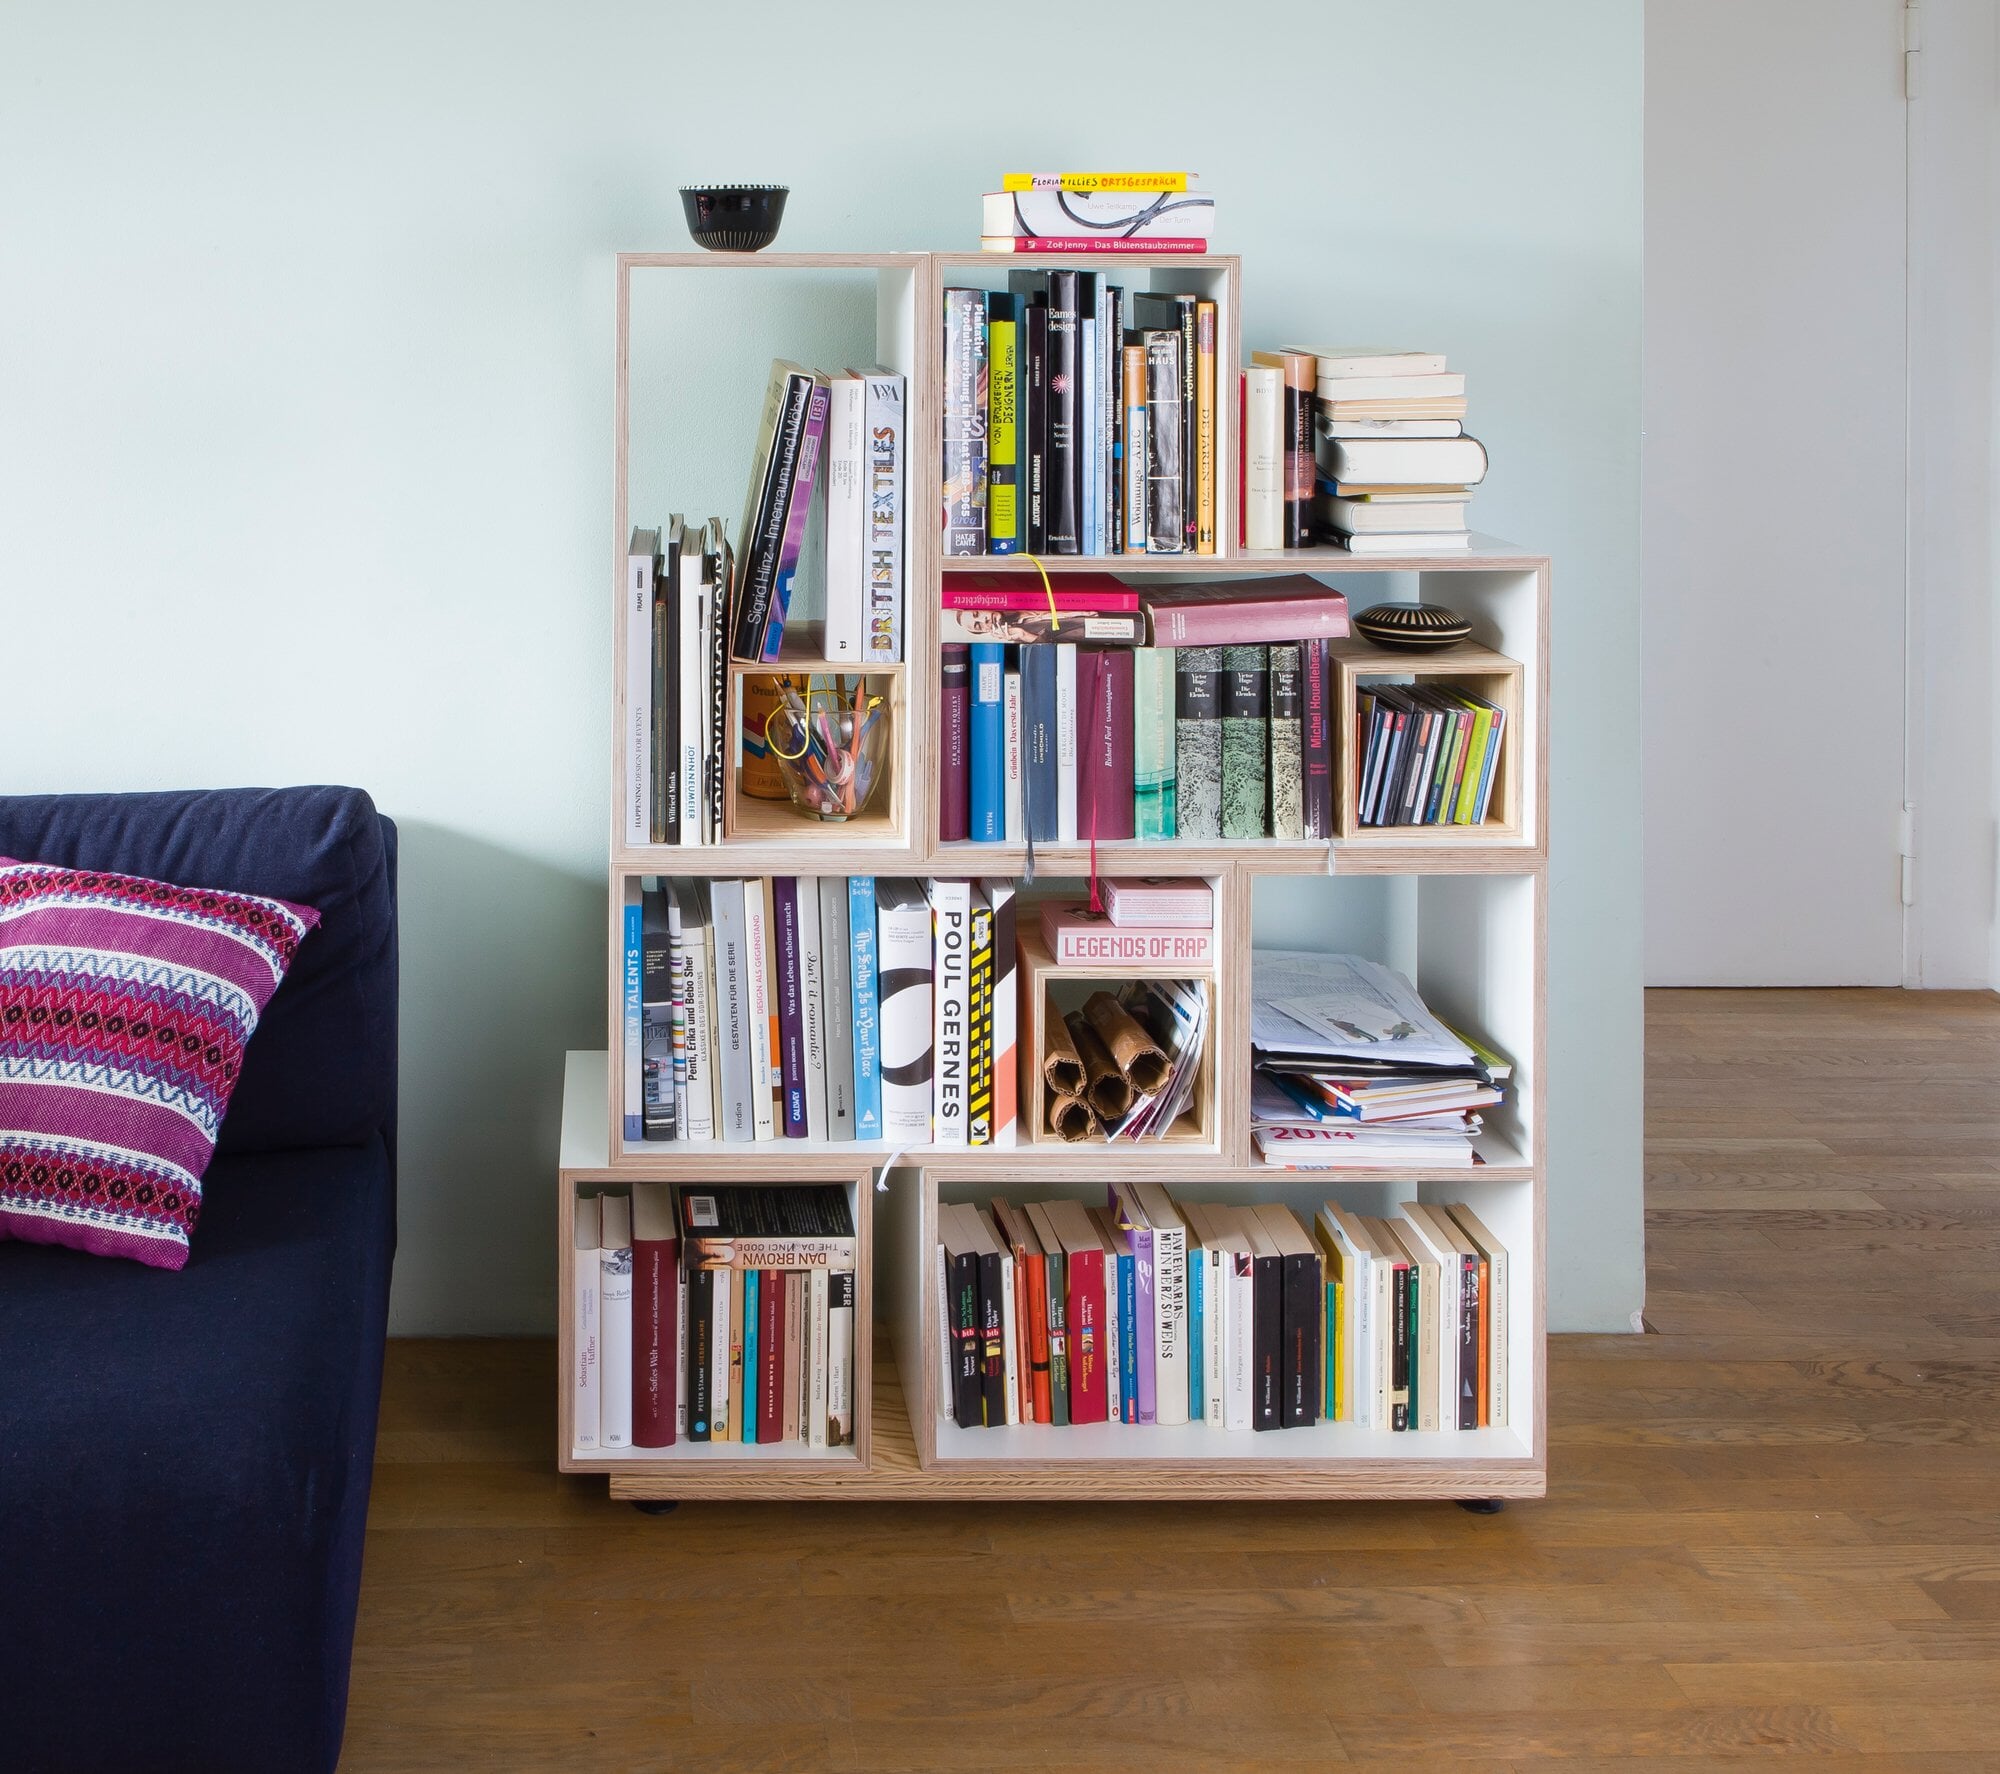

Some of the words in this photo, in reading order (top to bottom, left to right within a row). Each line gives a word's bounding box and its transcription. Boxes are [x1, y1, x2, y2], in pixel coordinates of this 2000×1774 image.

[1031, 177, 1066, 186] FLORIAN
[1067, 177, 1098, 187] ILLIES
[1100, 177, 1177, 187] ORTSGESPRÄCH
[1087, 202, 1104, 211] Uwe
[1172, 216, 1191, 224] Turm
[1046, 240, 1064, 249] Zoë
[1064, 240, 1088, 251] Jenny
[1094, 240, 1111, 249] Das
[1113, 240, 1195, 250] Blütenstaubzimmer
[1049, 308, 1077, 320] Eames
[974, 303, 985, 357] Plakativ!
[1048, 320, 1077, 334] design
[961, 304, 973, 402] Produktwerbung
[1148, 357, 1175, 365] HAUS
[1184, 313, 1196, 403] wohnraumfibel
[871, 384, 899, 402] V&A
[993, 369, 1003, 425] ERFOLGREICHEN
[1003, 370, 1015, 425] DESIGNERN
[786, 390, 806, 435] Möbel
[811, 398, 825, 418] SED
[963, 403, 973, 418] im
[1201, 408, 1210, 430] DE
[962, 420, 972, 458] Plakat
[994, 427, 1003, 446] VON
[780, 437, 797, 465] und
[1201, 431, 1210, 482] JAREN
[871, 426, 895, 543] TEXTILES
[1033, 454, 1041, 493] HANDMADE
[764, 467, 791, 539] Innenraum
[1131, 468, 1145, 528] Wohnungs
[755, 552, 775, 582] Hinz
[747, 585, 769, 625] Sigrid
[871, 550, 895, 651] BRITISH
[1009, 694, 1017, 709] Jahr
[635, 707, 643, 737] EVENTS
[1104, 725, 1112, 741] Ford
[1309, 711, 1322, 749] Michel
[635, 737, 643, 753] FOR
[1009, 729, 1017, 743] Das
[688, 745, 696, 771] JOHN
[1009, 747, 1018, 780] Grünbein
[1104, 742, 1113, 767] Richard
[634, 754, 643, 782] DESIGN
[668, 771, 677, 795] Minks
[634, 783, 643, 828] HAPPENING
[688, 772, 696, 820] NEUMEIER
[668, 794, 677, 824] Wilfried
[986, 812, 994, 835] MALIK
[783, 902, 793, 926] macht
[753, 914, 762, 967] GEGENSTAND
[784, 927, 794, 959] schöner
[853, 928, 874, 953] The
[977, 921, 985, 940] SIGNS
[727, 941, 736, 966] SERIE
[943, 911, 963, 990] POUL
[1064, 937, 1146, 958] LEGENDS
[1149, 937, 1172, 958] OF
[1174, 937, 1208, 958] RAP
[683, 956, 693, 978] Sher
[728, 968, 736, 982] DIE
[755, 970, 763, 983] ALS
[785, 960, 795, 983] Leben
[853, 953, 873, 989] Selby
[627, 949, 639, 1011] TALENTS
[684, 980, 694, 1005] Bebo
[728, 984, 737, 1001] FÜR
[786, 984, 796, 998] das
[756, 985, 764, 1015] DESIGN
[788, 999, 797, 1016] Was
[860, 1006, 873, 1018] in
[685, 1007, 695, 1025] und
[698, 1015, 706, 1027] DES
[730, 1003, 740, 1050] GESTALTEN
[628, 1017, 639, 1046] NEW
[686, 1028, 697, 1051] Erika
[688, 1054, 698, 1081] Penti,
[862, 1046, 876, 1077] Place
[941, 999, 962, 1118] GERNES
[791, 1063, 799, 1081] JUDITH
[735, 1102, 743, 1129] Hirdina
[791, 1090, 801, 1121] CALLWEY
[973, 1126, 986, 1137] K
[1269, 1127, 1357, 1140] 2014
[737, 1243, 766, 1252] CODE
[743, 1252, 796, 1265] BROWN
[798, 1252, 828, 1265] DAN
[801, 1243, 815, 1252] DA
[819, 1243, 838, 1252] THE
[1161, 1234, 1172, 1267] MEIN
[1173, 1233, 1183, 1273] JAVIER
[843, 1277, 852, 1306] PIPER
[1161, 1269, 1172, 1302] HERZ
[1397, 1270, 1405, 1291] AUSTEN
[1173, 1276, 1184, 1320] MARIAS
[1161, 1305, 1172, 1320] SO
[1161, 1322, 1173, 1360] WEISS
[1397, 1319, 1405, 1346] PREJUDICE
[588, 1335, 597, 1365] Haffner
[649, 1348, 658, 1367] Welt
[579, 1351, 588, 1388] Sebastian
[815, 1369, 823, 1384] Zweig
[1236, 1355, 1244, 1377] Vargas
[649, 1367, 658, 1392] Sofies
[698, 1367, 706, 1391] STAMM
